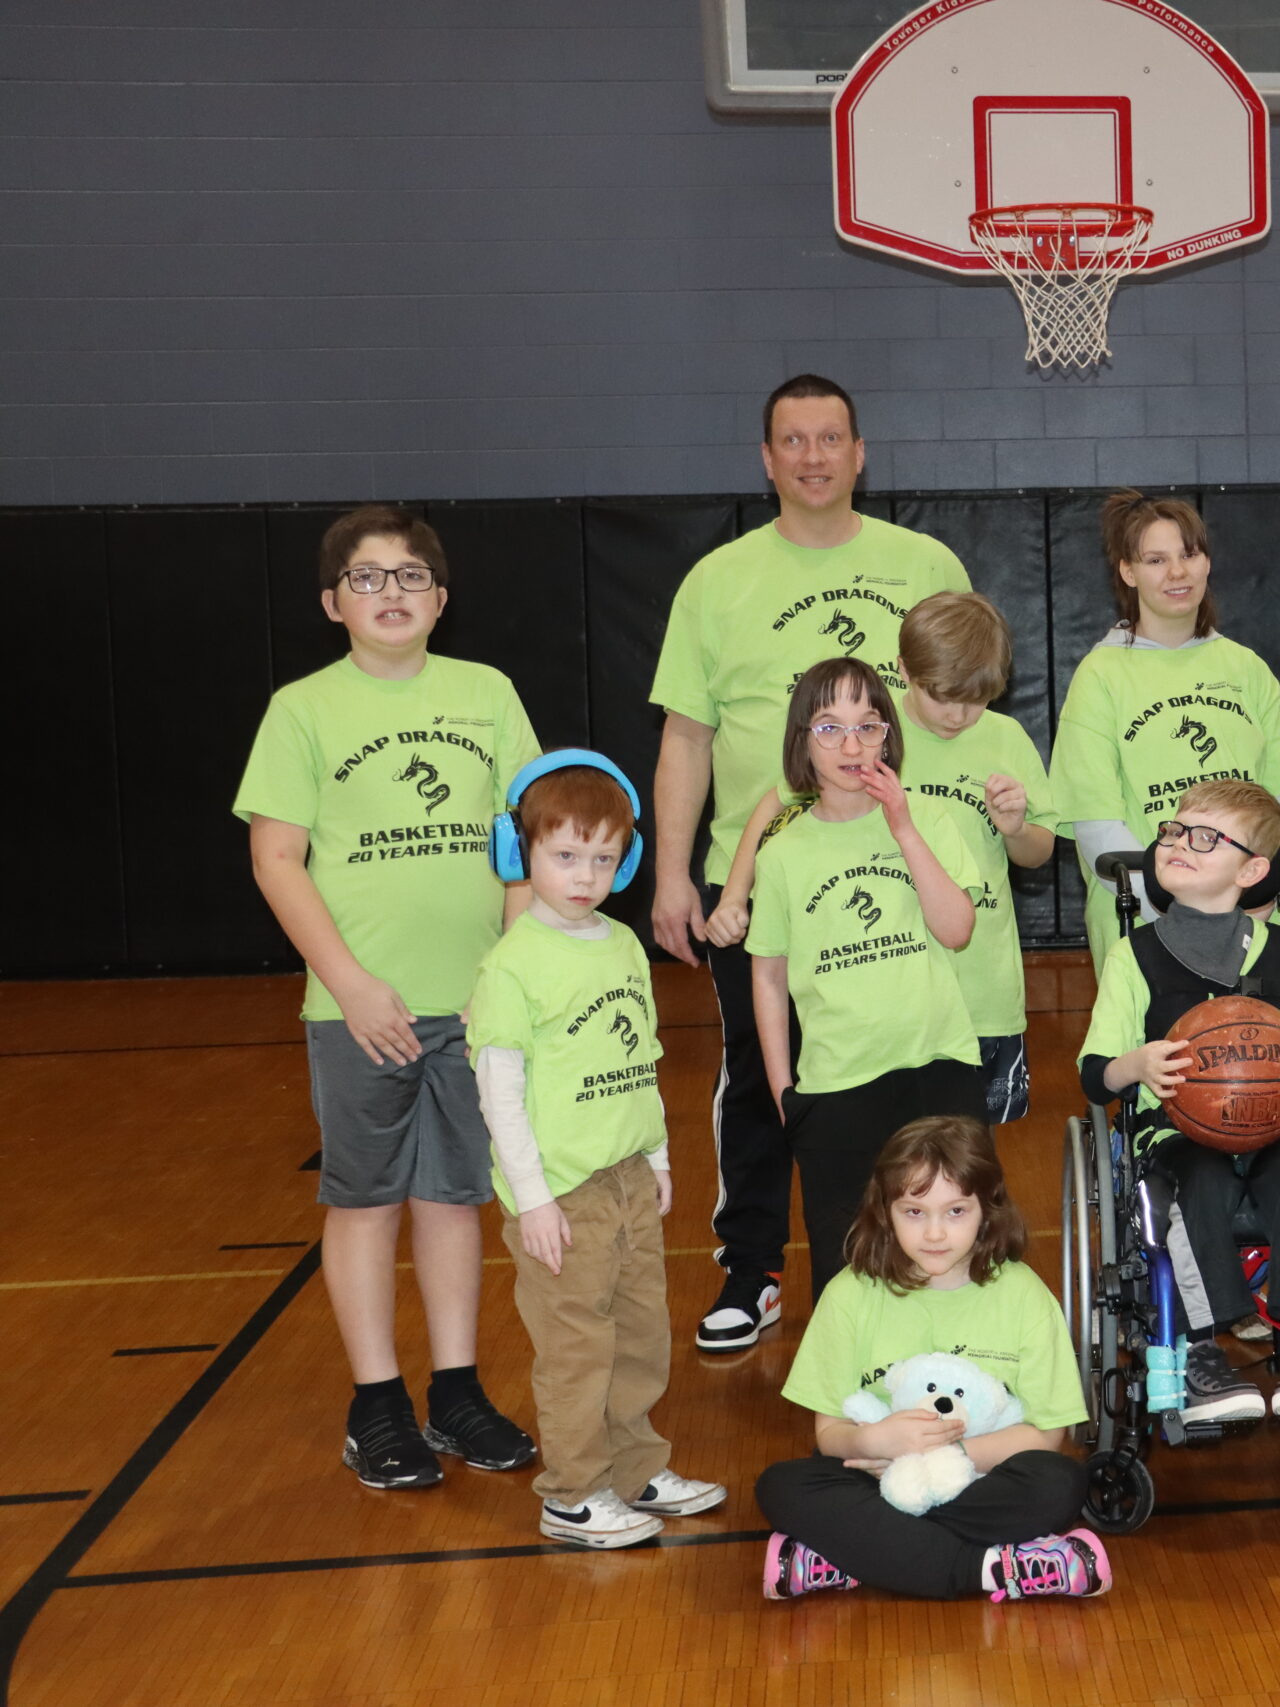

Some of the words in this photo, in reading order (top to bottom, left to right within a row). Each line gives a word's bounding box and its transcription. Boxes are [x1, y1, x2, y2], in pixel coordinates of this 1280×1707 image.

[884, 12, 932, 51] Younger
[1138, 0, 1214, 53] Performance
[1166, 247, 1184, 260] NO
[1187, 229, 1242, 254] DUNKING
[773, 595, 816, 632] SNAP
[822, 588, 909, 620] DRAGONS
[1124, 701, 1164, 742] SNAP
[334, 736, 390, 783] SNAP
[397, 730, 494, 772] DRAGONS
[1144, 800, 1164, 814] 20
[360, 823, 489, 847] BASKETBALL
[347, 851, 372, 864] 20
[379, 843, 443, 861] YEARS
[449, 841, 489, 854] STRO
[805, 876, 840, 914] SNAP
[815, 963, 831, 975] 20
[835, 954, 877, 970] YEARS
[880, 942, 927, 960] STRONG
[820, 931, 915, 961] BASKETBALL
[567, 997, 605, 1036] SNAP
[575, 1090, 595, 1102] 20
[599, 1081, 634, 1098] YEARS
[636, 1076, 657, 1090] STRO
[583, 1062, 657, 1088] BASKETBAL
